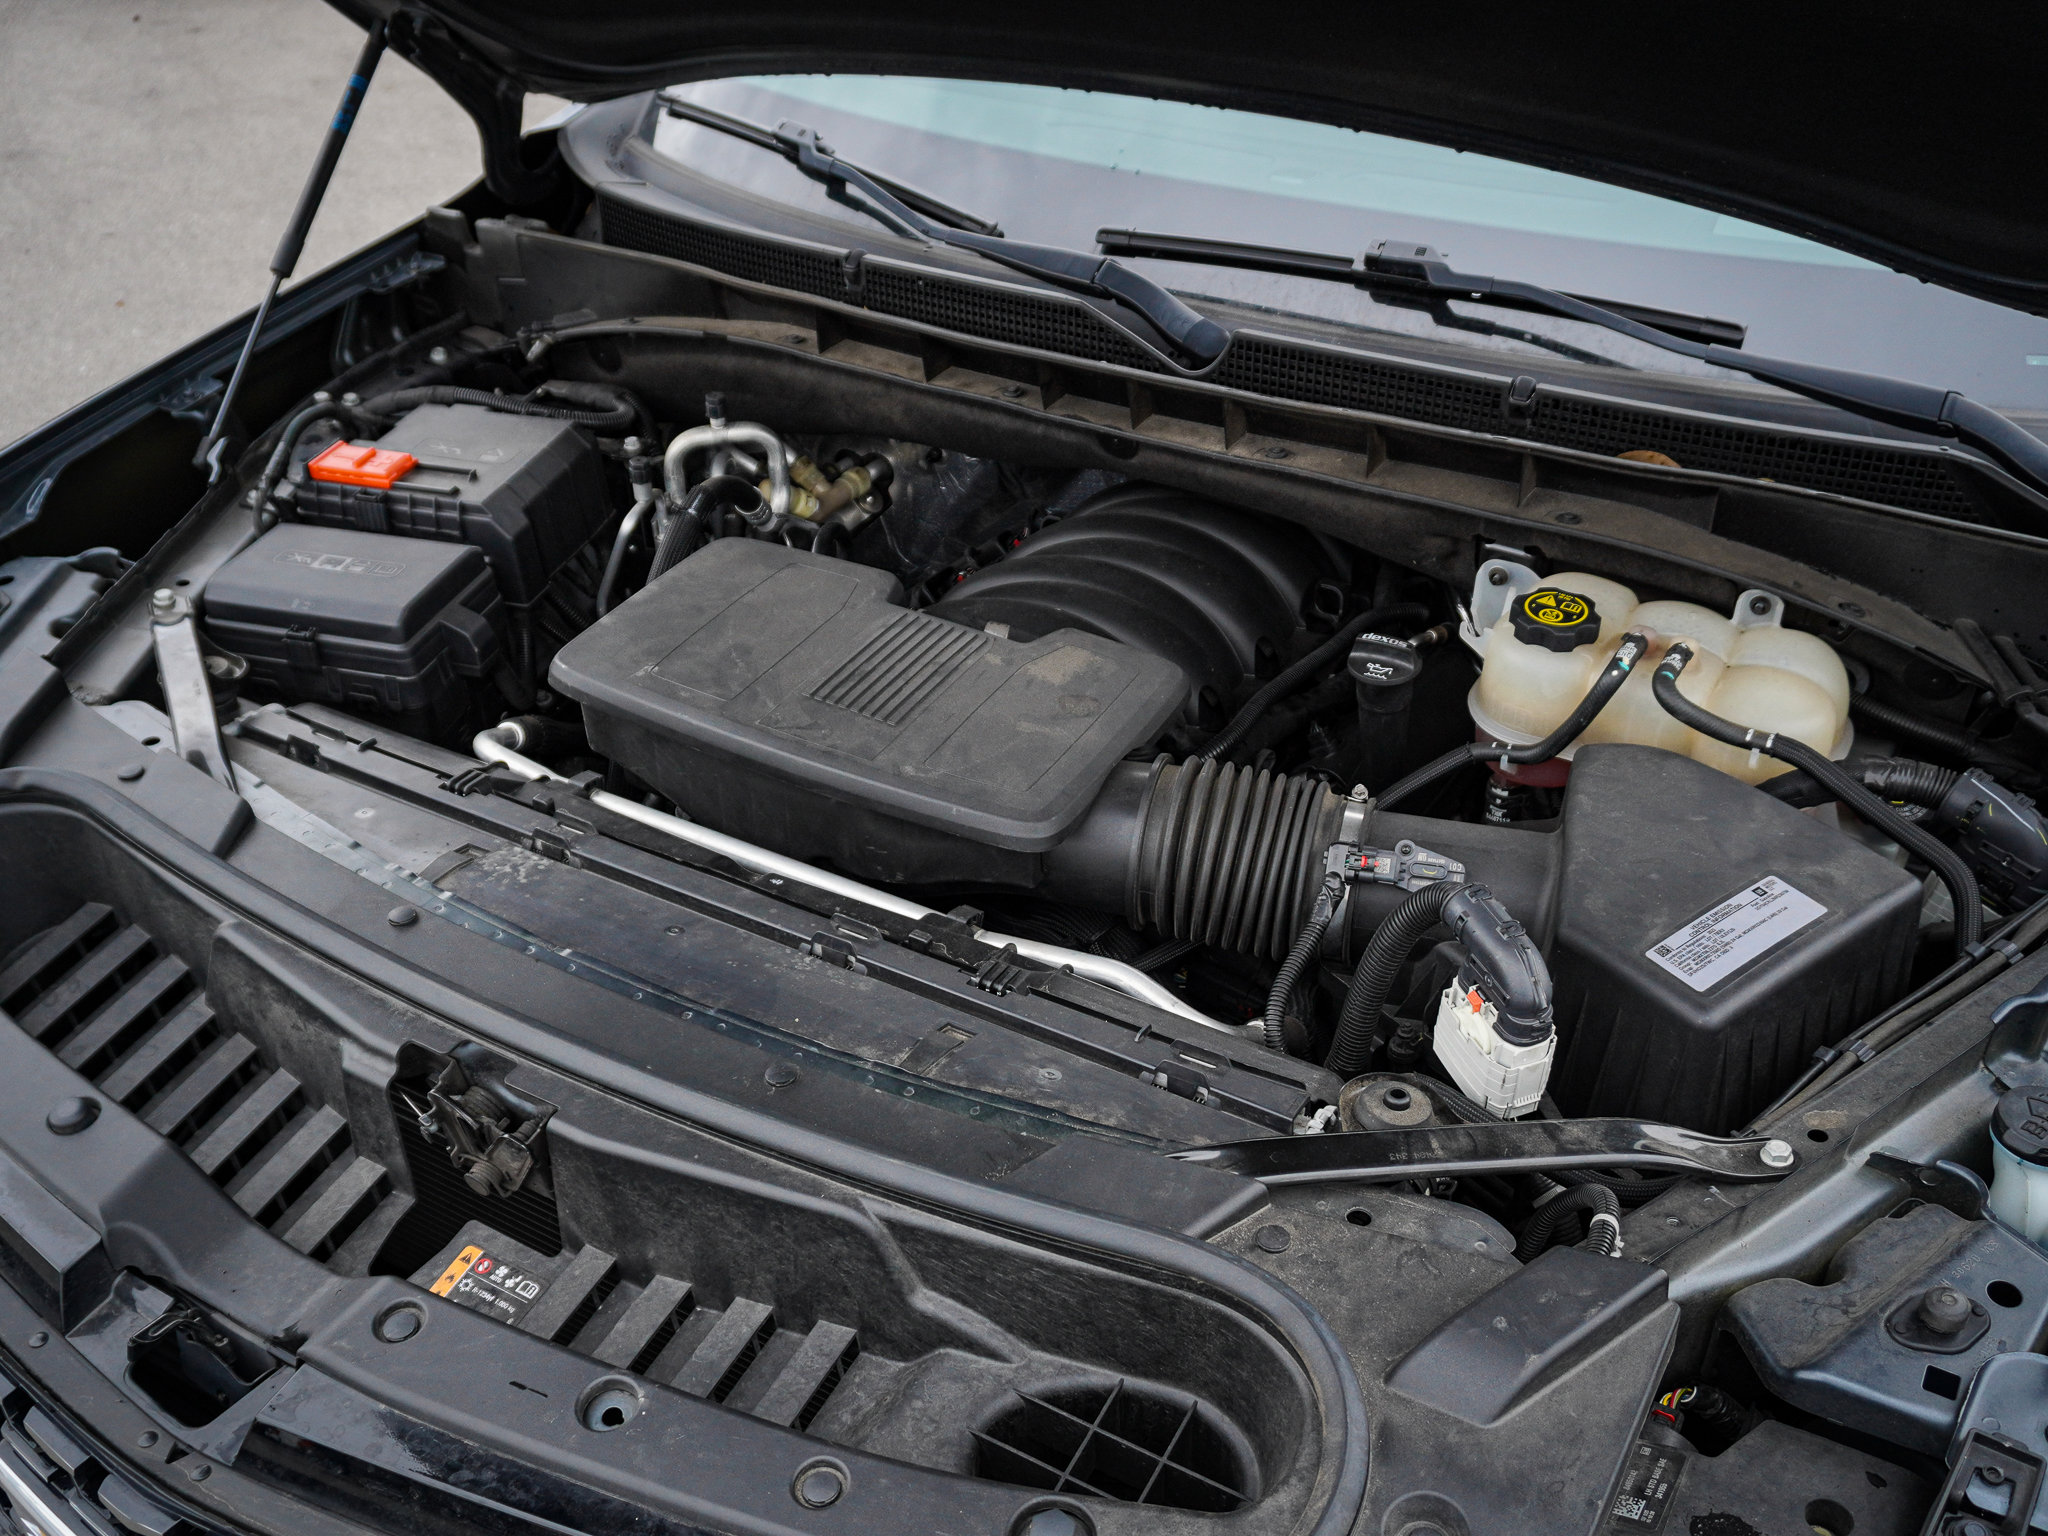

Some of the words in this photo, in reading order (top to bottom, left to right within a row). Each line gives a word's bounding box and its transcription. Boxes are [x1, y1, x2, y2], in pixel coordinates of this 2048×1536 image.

[1361, 632, 1408, 648] dexos
[1689, 923, 1712, 937] CONTROL
[1711, 903, 1743, 923] INFORMATION
[1690, 917, 1711, 930] VEHICLE
[1710, 903, 1733, 917] EMISSION
[489, 1274, 502, 1283] AUTO
